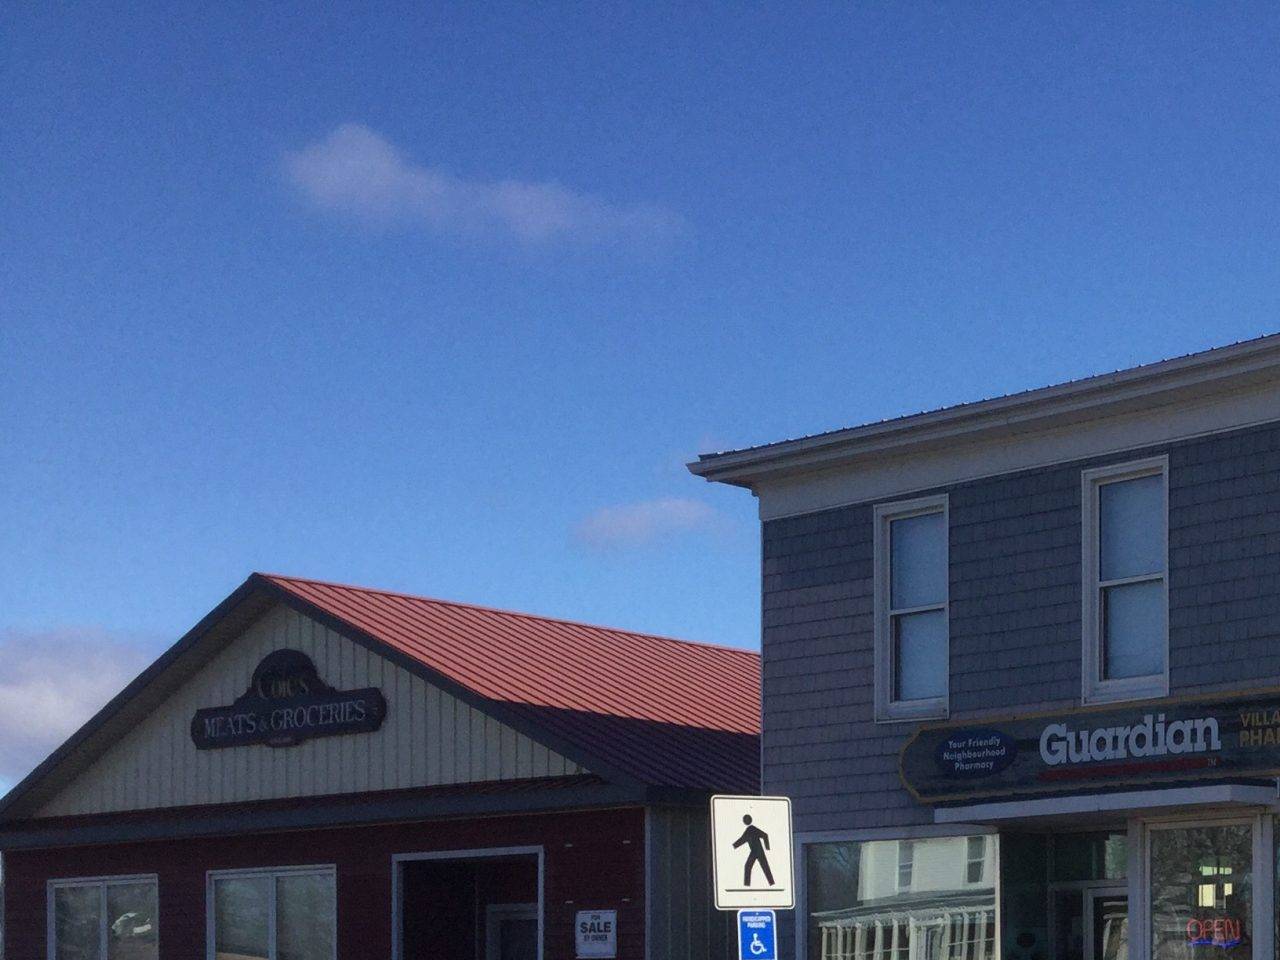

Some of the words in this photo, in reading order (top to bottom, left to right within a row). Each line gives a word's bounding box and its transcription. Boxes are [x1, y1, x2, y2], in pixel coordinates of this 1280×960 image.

[203, 713, 256, 740] MEATS
[271, 700, 366, 731] GROCERIES
[948, 740, 966, 749] Your
[968, 736, 1001, 747] Friendly
[1039, 714, 1221, 766] Guardian
[943, 747, 1006, 761] Neighbourhood
[954, 760, 994, 771] Pharmacy
[580, 922, 612, 934] SALE
[1186, 918, 1241, 942] OPEN
